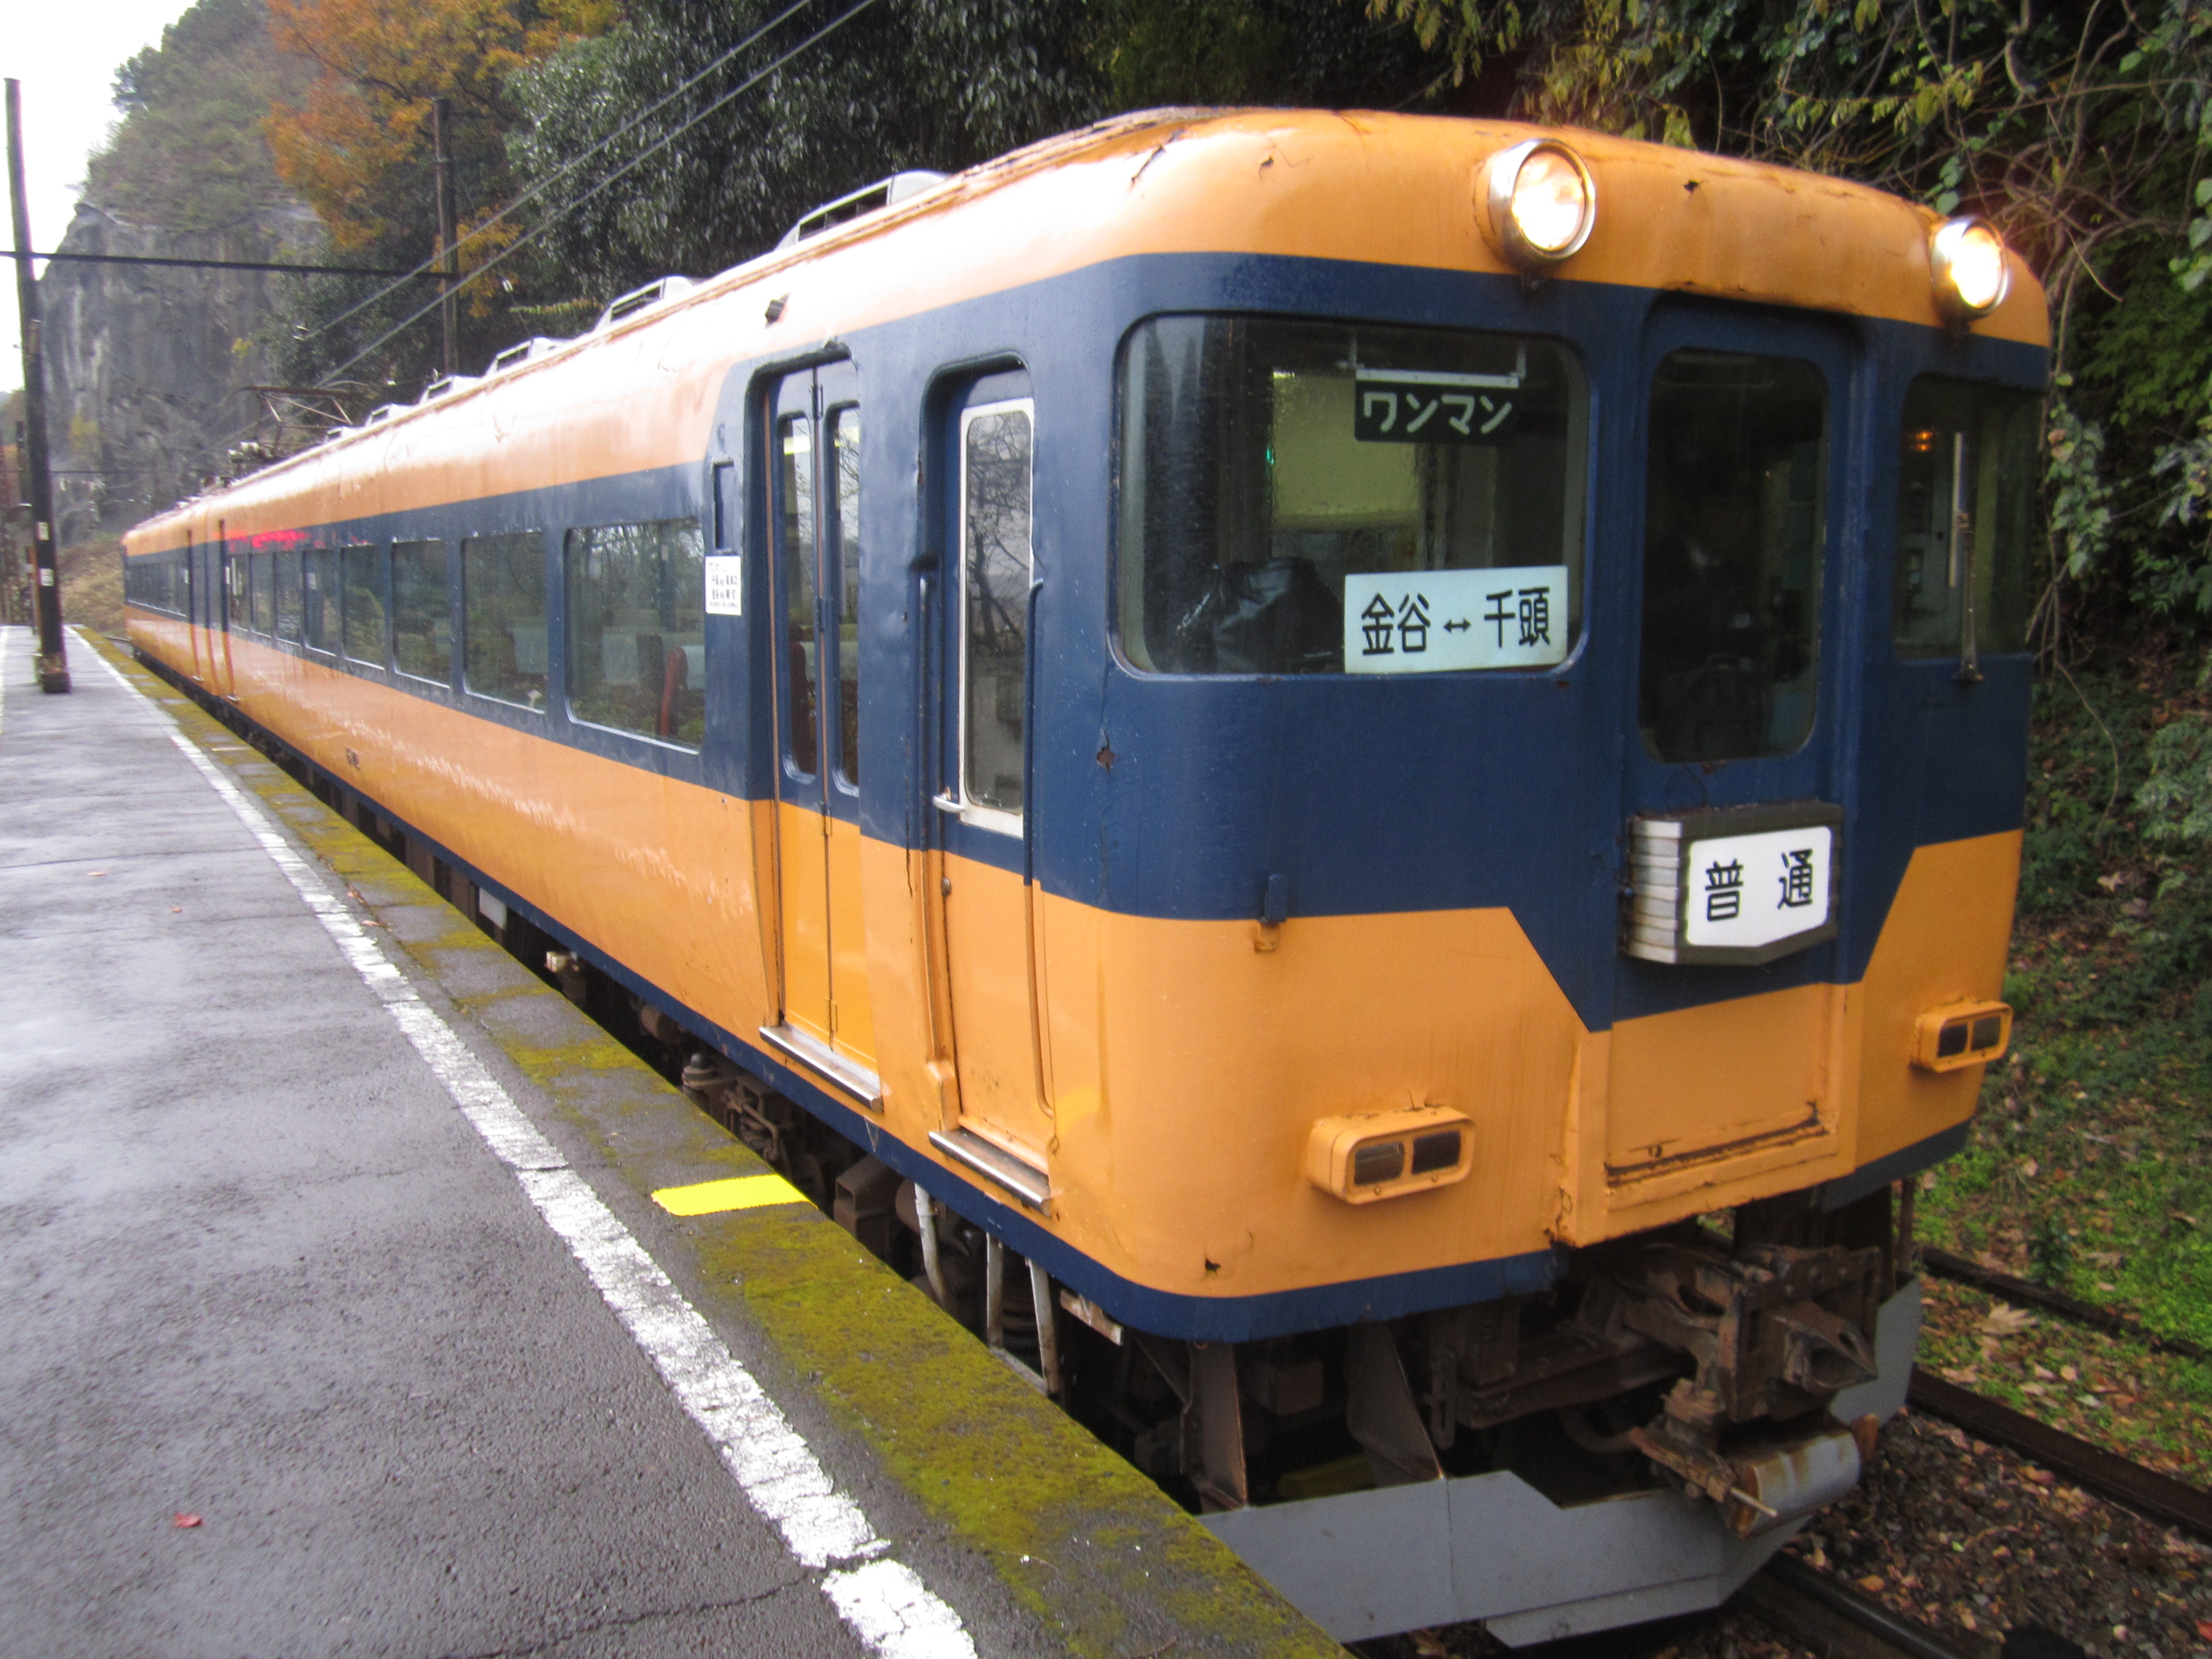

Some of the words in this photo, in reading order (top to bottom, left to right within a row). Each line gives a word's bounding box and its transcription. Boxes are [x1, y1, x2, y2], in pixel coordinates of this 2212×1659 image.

[1363, 392, 1513, 435] ワンマン
[1361, 592, 1431, 656] 金谷
[1483, 586, 1551, 648] 千頭
[1705, 848, 1813, 922] 普通
